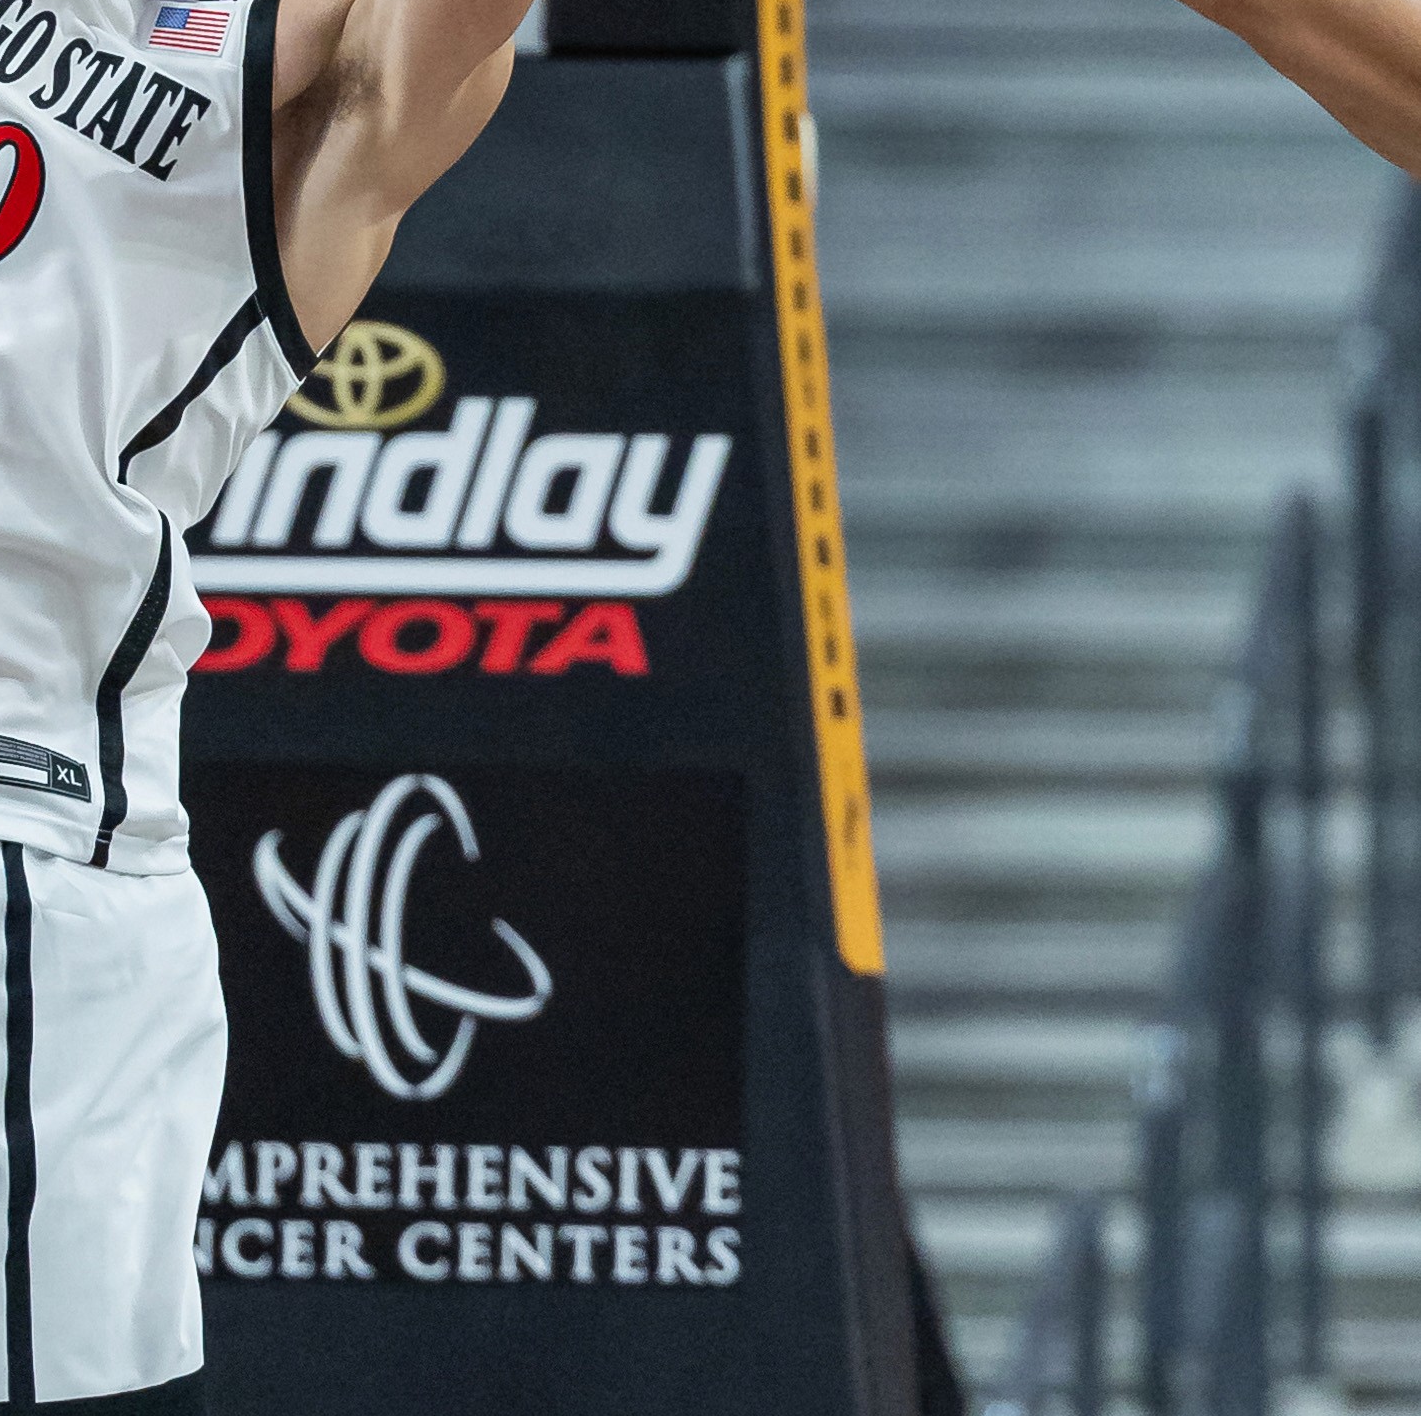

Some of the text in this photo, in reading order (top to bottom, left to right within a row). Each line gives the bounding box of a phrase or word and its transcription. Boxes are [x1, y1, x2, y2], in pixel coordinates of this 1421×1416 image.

[29, 36, 212, 182] STATE
[191, 396, 735, 598] indlay
[191, 597, 650, 677] OYOTA
[56, 764, 83, 787] XL
[201, 1140, 742, 1216] MPREHENSIVE
[397, 1220, 742, 1285] CENTERS
